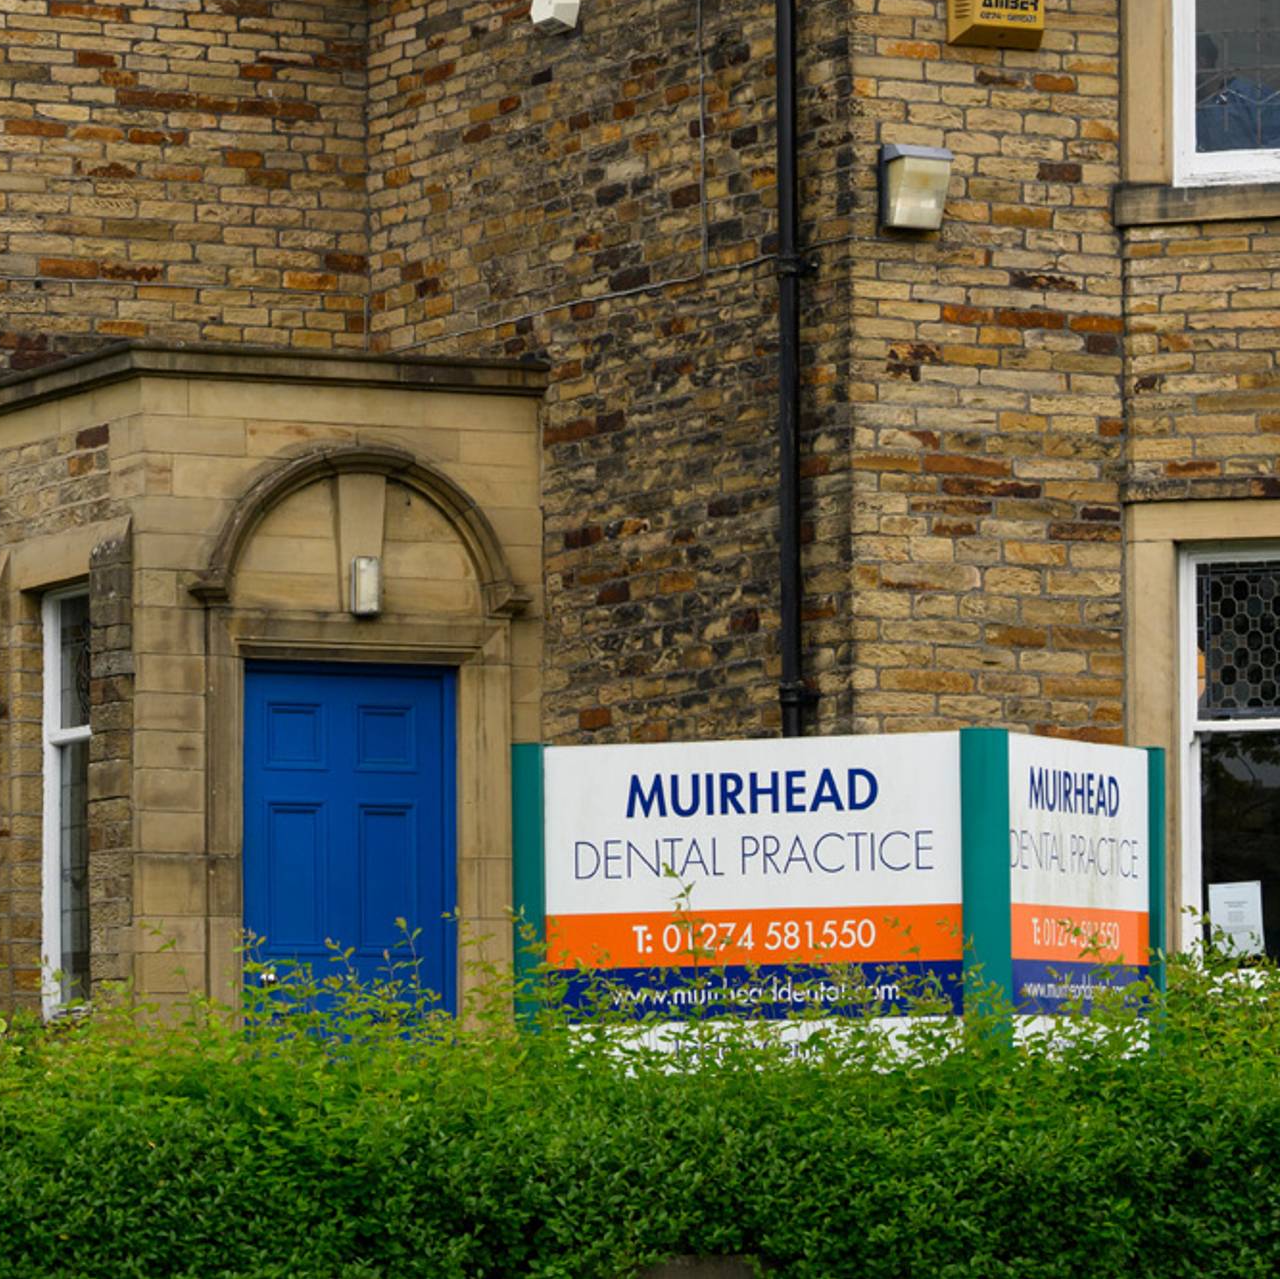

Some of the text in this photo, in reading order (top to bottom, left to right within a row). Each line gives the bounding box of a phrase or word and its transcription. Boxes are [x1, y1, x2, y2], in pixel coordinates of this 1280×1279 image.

[625, 767, 880, 819] MUIRHEAD
[1029, 765, 1120, 818] MUIRHEAD
[573, 829, 935, 881] DENTAL PRACTICE
[1010, 828, 1139, 879] DENTAL PRACTICE
[632, 918, 877, 954] T: 01274 581550
